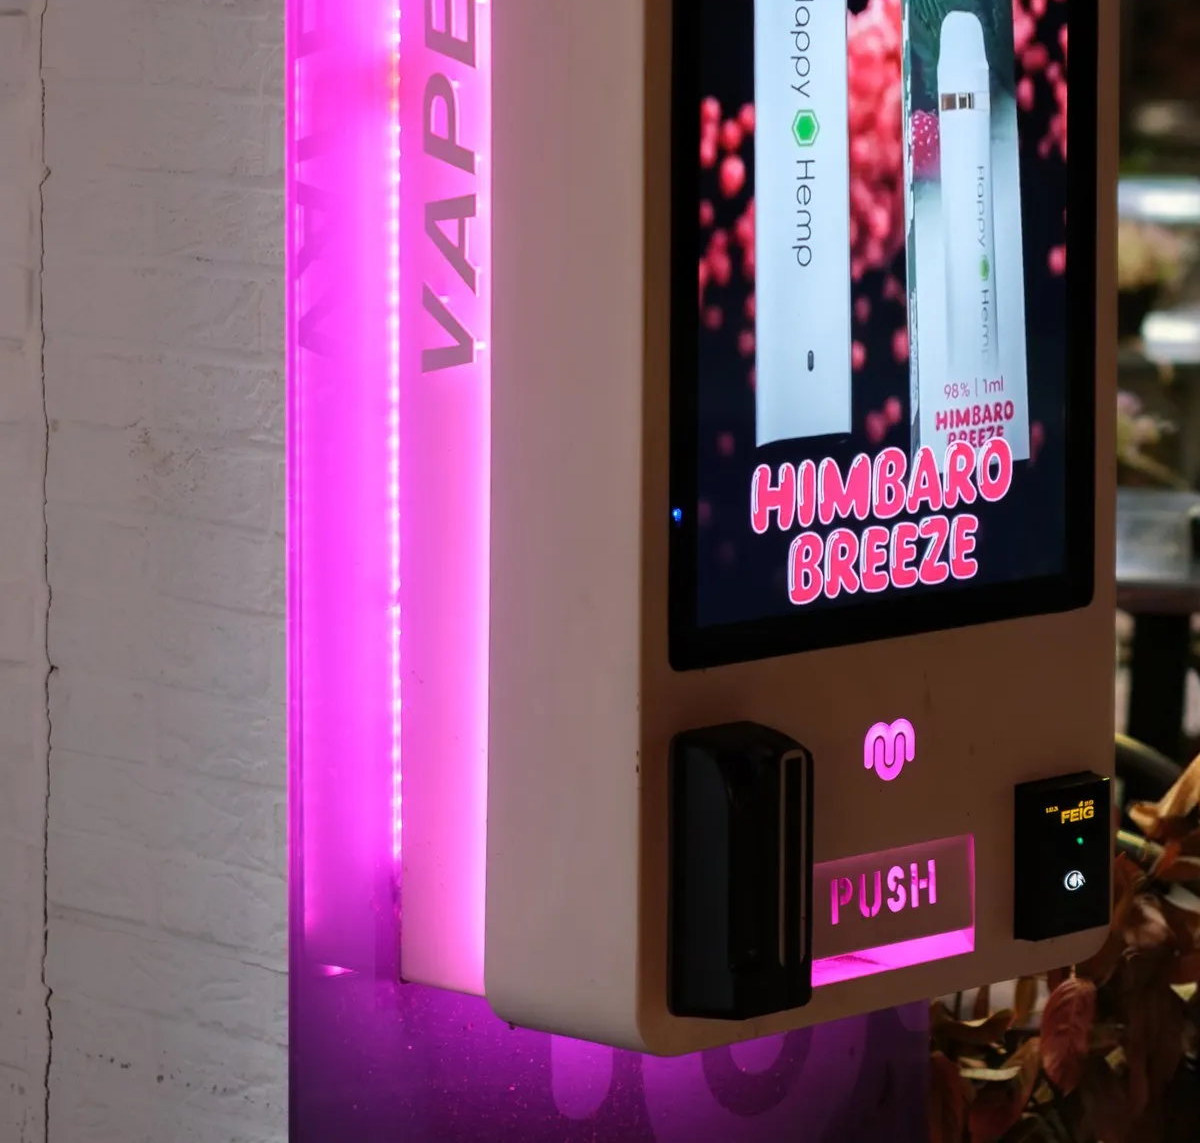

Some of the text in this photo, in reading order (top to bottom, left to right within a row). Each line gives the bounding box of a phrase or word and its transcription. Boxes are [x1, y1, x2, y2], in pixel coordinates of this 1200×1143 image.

[791, 159, 815, 267] Hemp
[976, 165, 986, 248] Happy
[936, 400, 1014, 431] HIMBARO
[944, 375, 1004, 399] 98% 1ml
[750, 437, 1013, 534] HIMBARO
[788, 514, 979, 605] BREEZE
[1061, 805, 1095, 824] FEIG
[831, 859, 937, 925] PUSH
